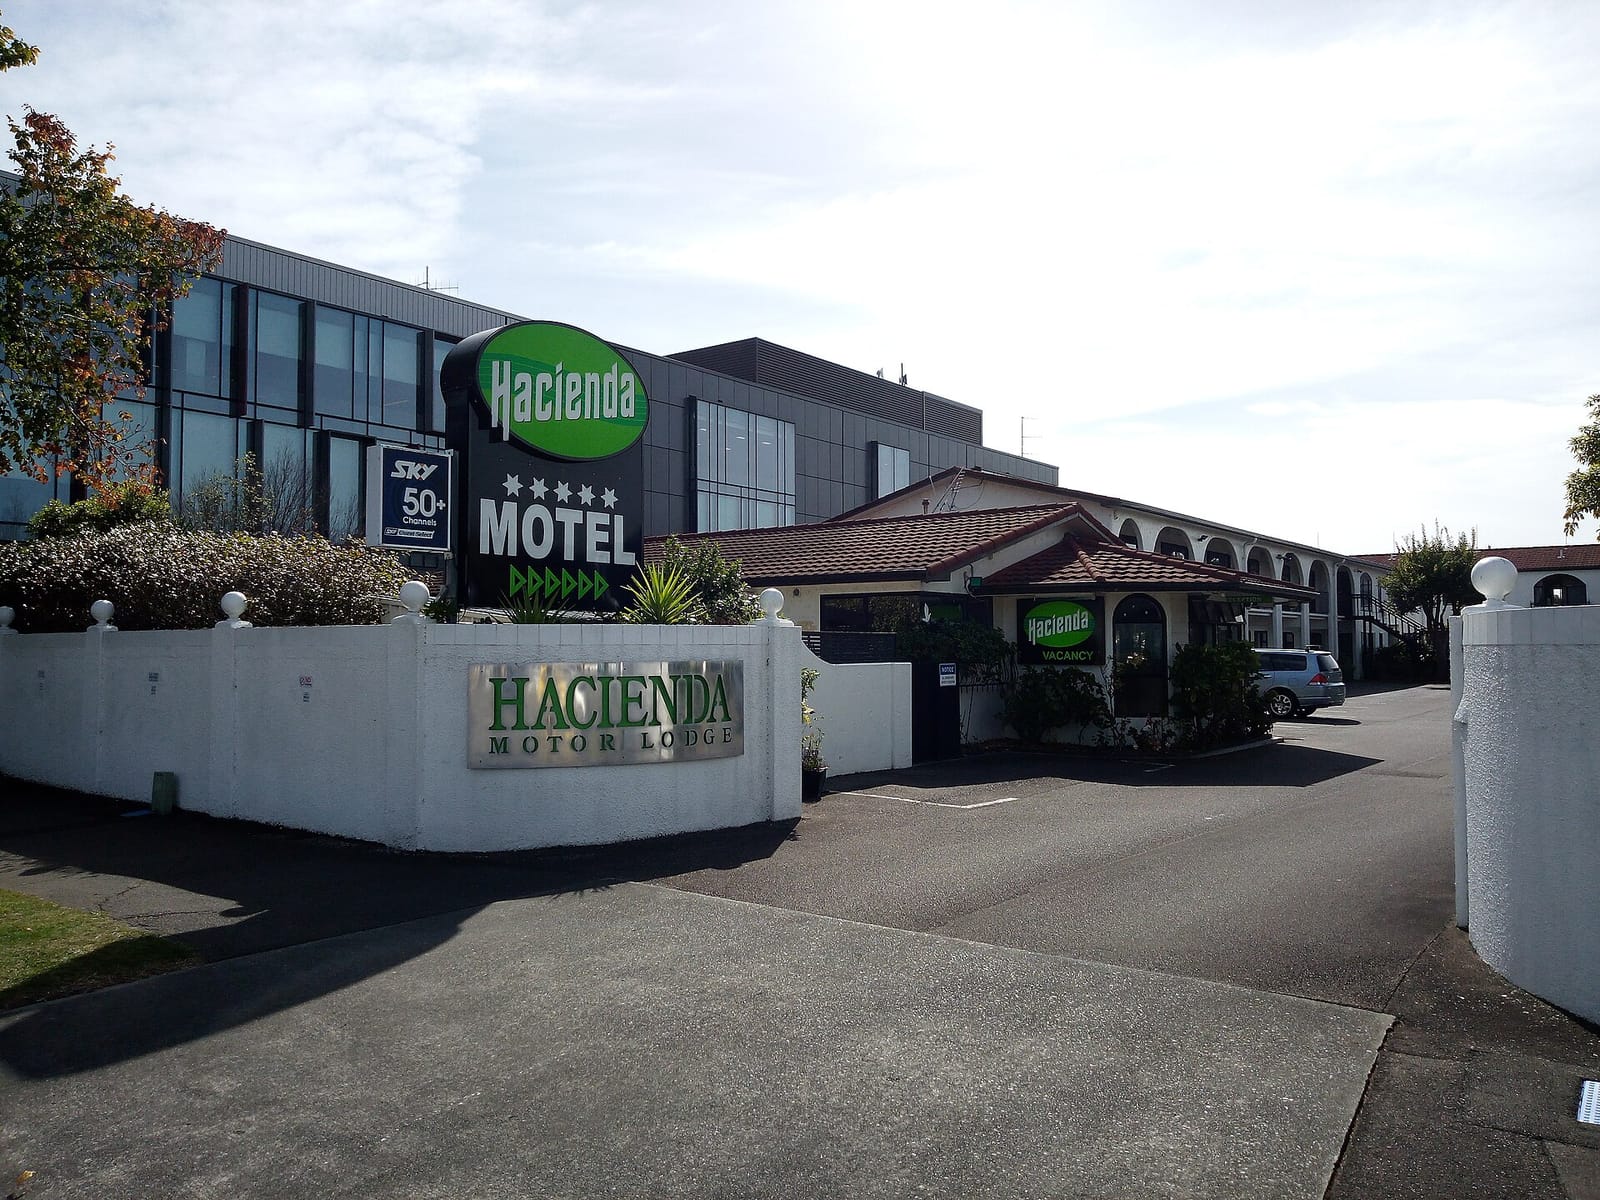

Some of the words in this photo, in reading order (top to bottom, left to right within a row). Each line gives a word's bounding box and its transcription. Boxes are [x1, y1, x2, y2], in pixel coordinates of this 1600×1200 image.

[491, 360, 636, 441] Hacienda
[390, 460, 438, 480] SKY
[402, 487, 446, 518] 50+
[402, 516, 437, 527] Channels
[479, 498, 636, 566] MOTEL
[1028, 608, 1089, 646] Hacienda
[1042, 650, 1094, 661] VACANCY
[488, 674, 732, 731] HACIENDA
[489, 733, 616, 754] MOTOR
[641, 727, 733, 750] LODGE
